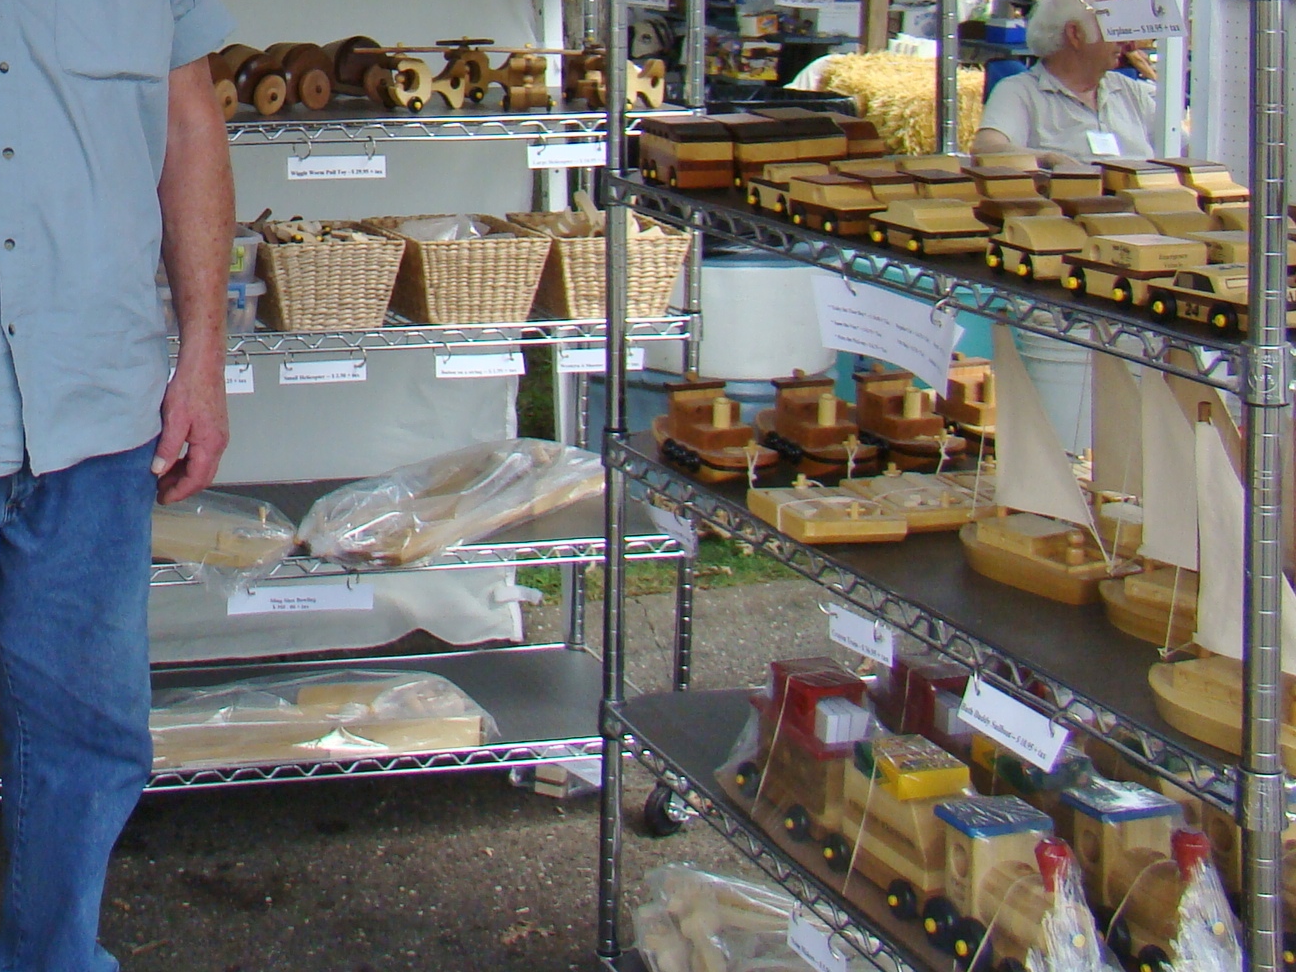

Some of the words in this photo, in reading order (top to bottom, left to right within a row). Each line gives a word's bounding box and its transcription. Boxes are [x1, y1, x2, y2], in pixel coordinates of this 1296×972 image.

[1170, 24, 1180, 32] tax
[1184, 302, 1200, 316] 24
[1038, 748, 1046, 760] tax
